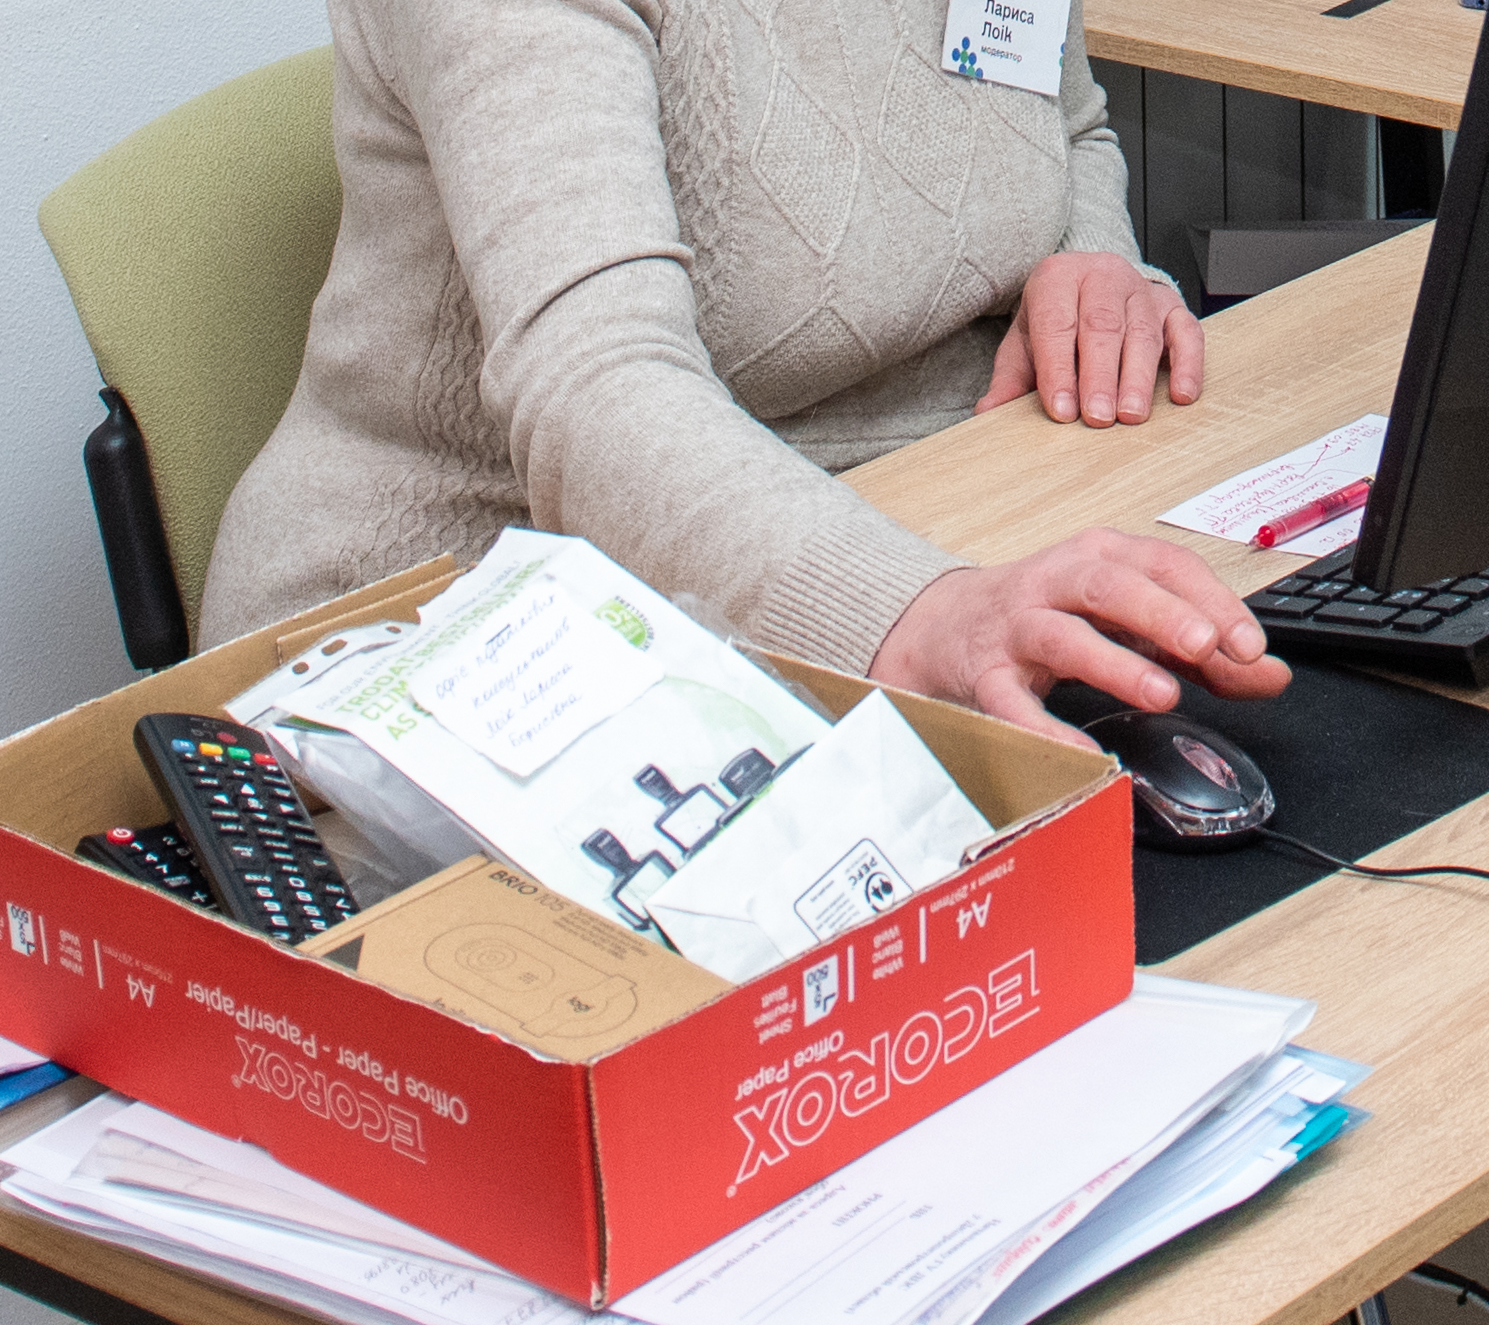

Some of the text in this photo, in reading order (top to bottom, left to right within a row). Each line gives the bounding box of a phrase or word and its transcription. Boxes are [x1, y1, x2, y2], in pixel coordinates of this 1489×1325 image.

[981, 21, 1012, 43] Лоік
[981, 45, 1022, 63] модератор
[335, 656, 415, 714] TRODAT
[386, 711, 418, 741] AS
[488, 866, 567, 914] BRIO 105
[11, 905, 29, 924] 500
[956, 893, 991, 939] A4
[125, 973, 155, 1008] A4
[806, 964, 829, 987] 500
[872, 956, 904, 980] White
[186, 979, 317, 1068] Paper/Papier
[759, 1019, 792, 1044] Sheet
[336, 1048, 400, 1098] Paper
[733, 948, 1040, 1186] ECOROX
[736, 1029, 844, 1103] Office Paper
[233, 1033, 426, 1165] ECOROX
[406, 1075, 469, 1125] Office
